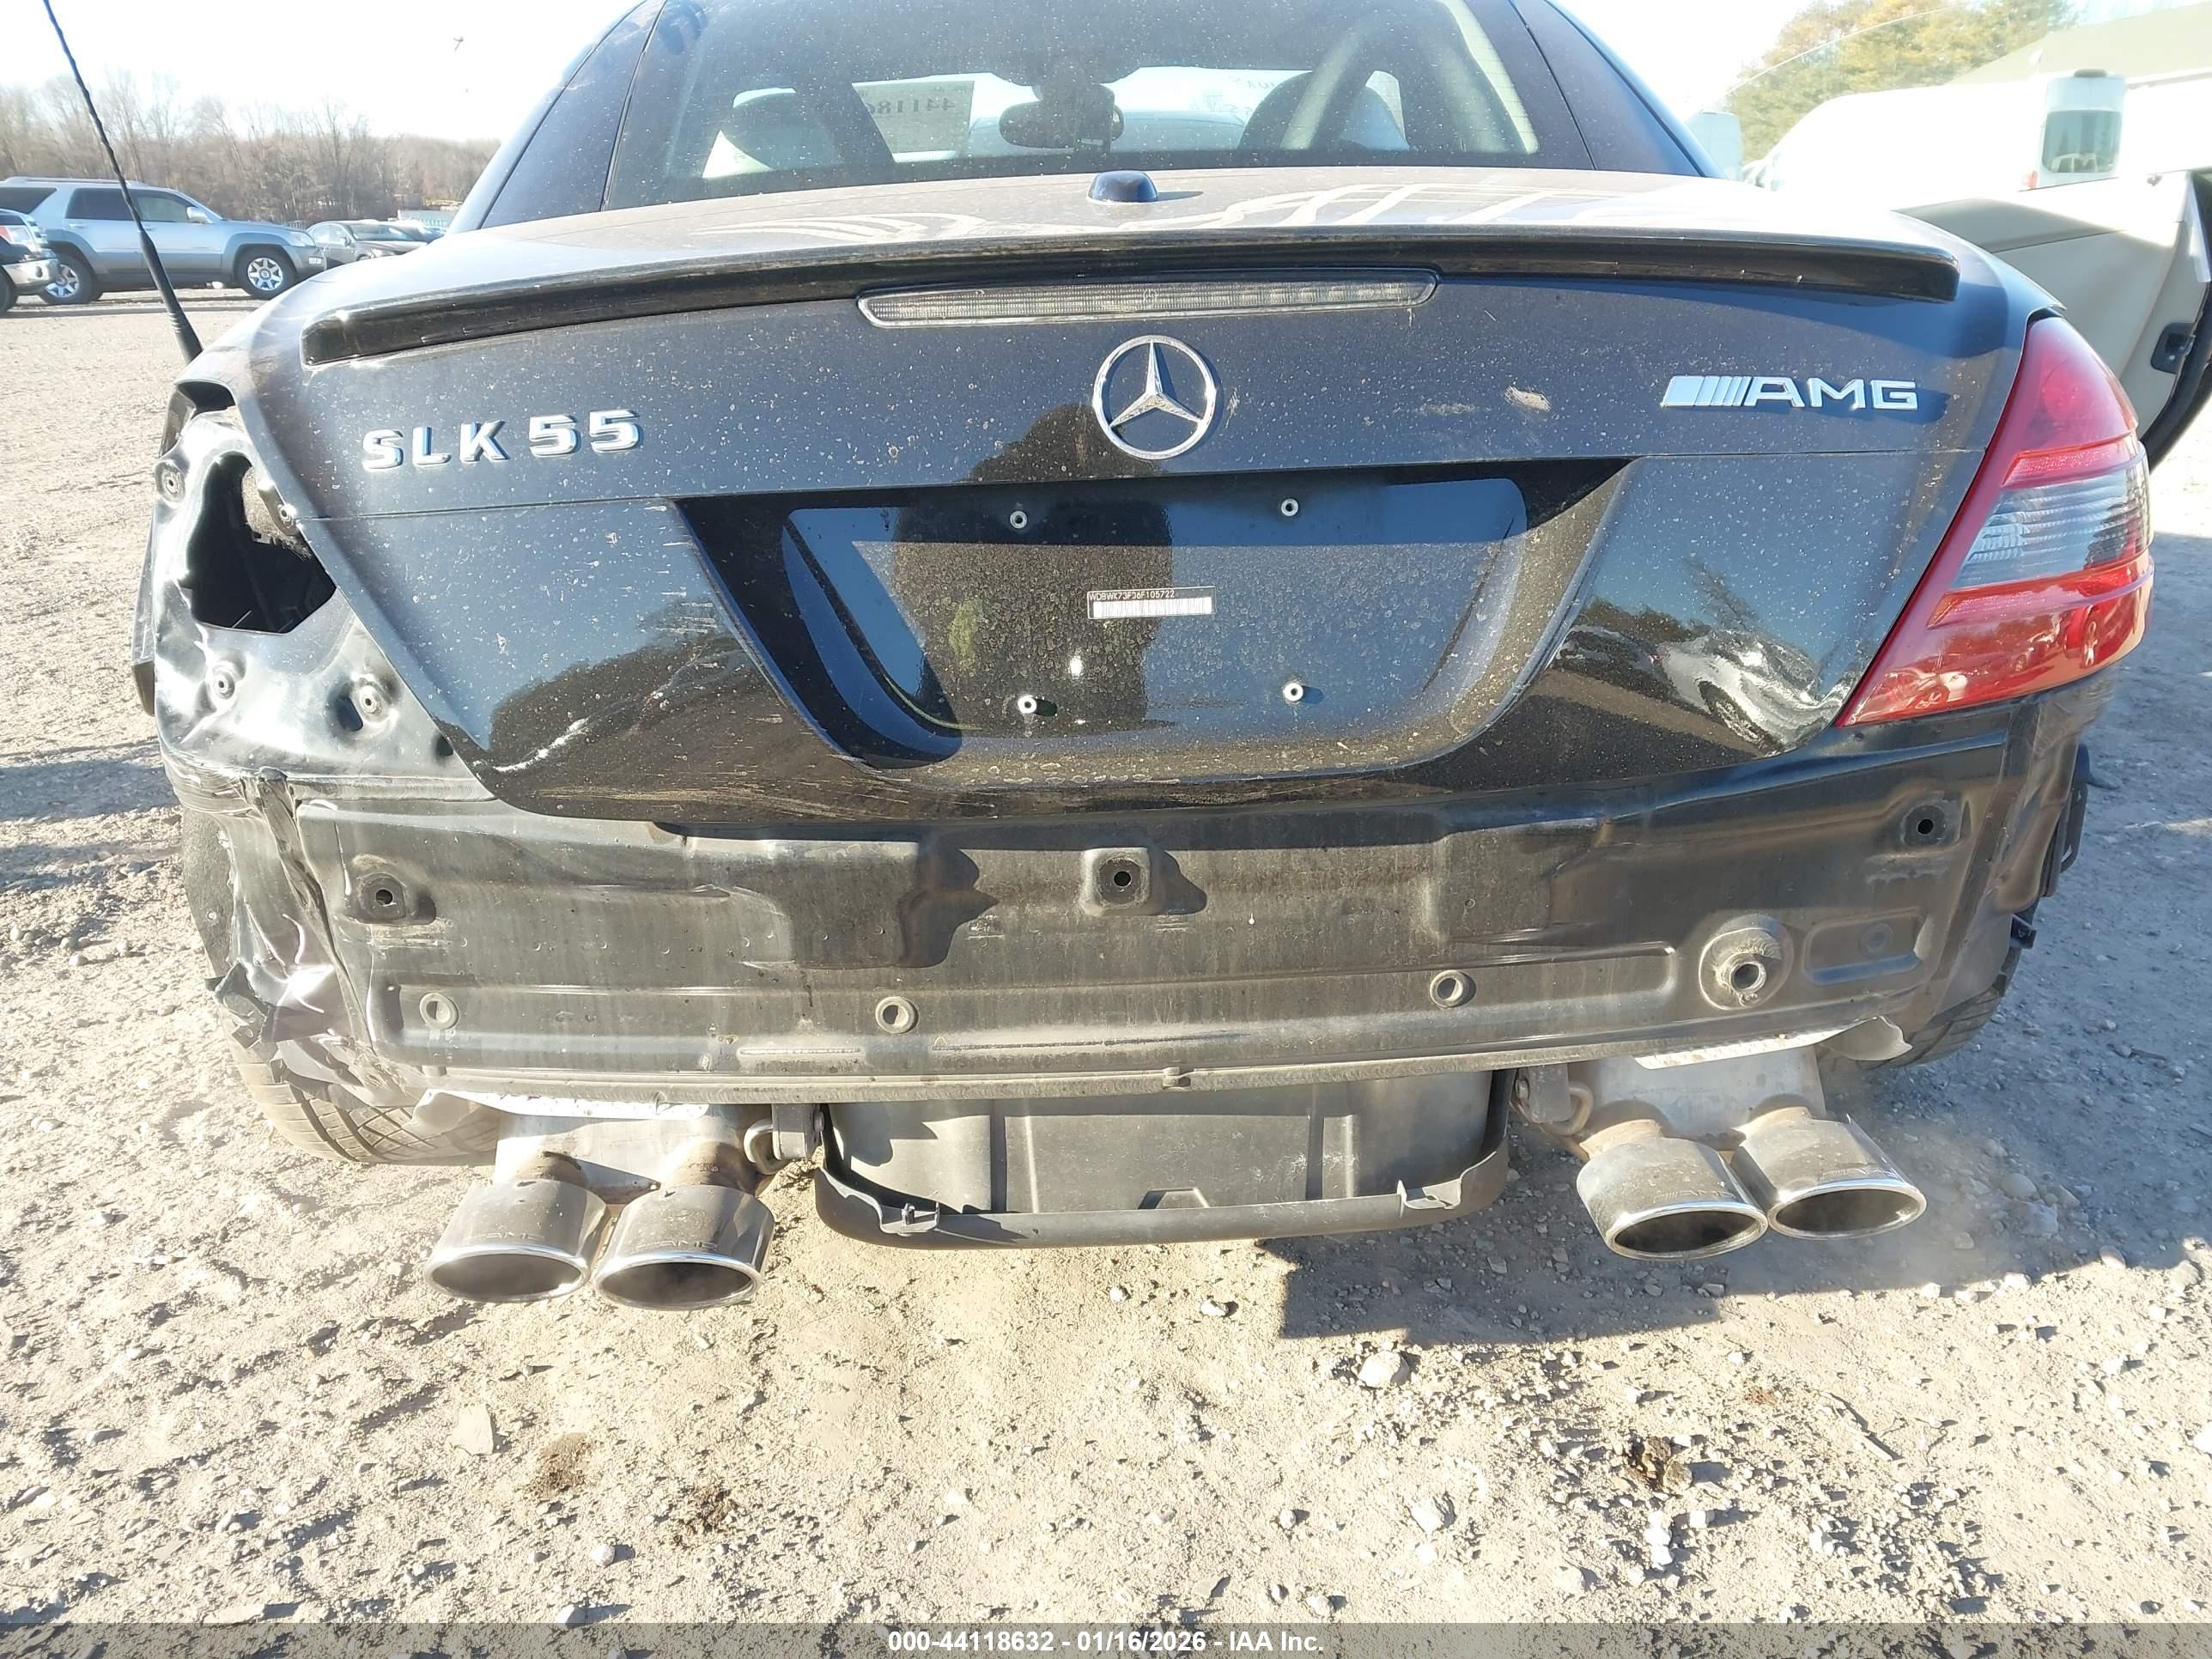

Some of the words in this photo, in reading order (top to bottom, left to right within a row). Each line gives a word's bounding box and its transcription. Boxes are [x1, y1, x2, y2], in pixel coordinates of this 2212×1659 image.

[1743, 375, 1918, 410] AMG
[362, 419, 510, 472] SLK
[528, 408, 644, 459] 55
